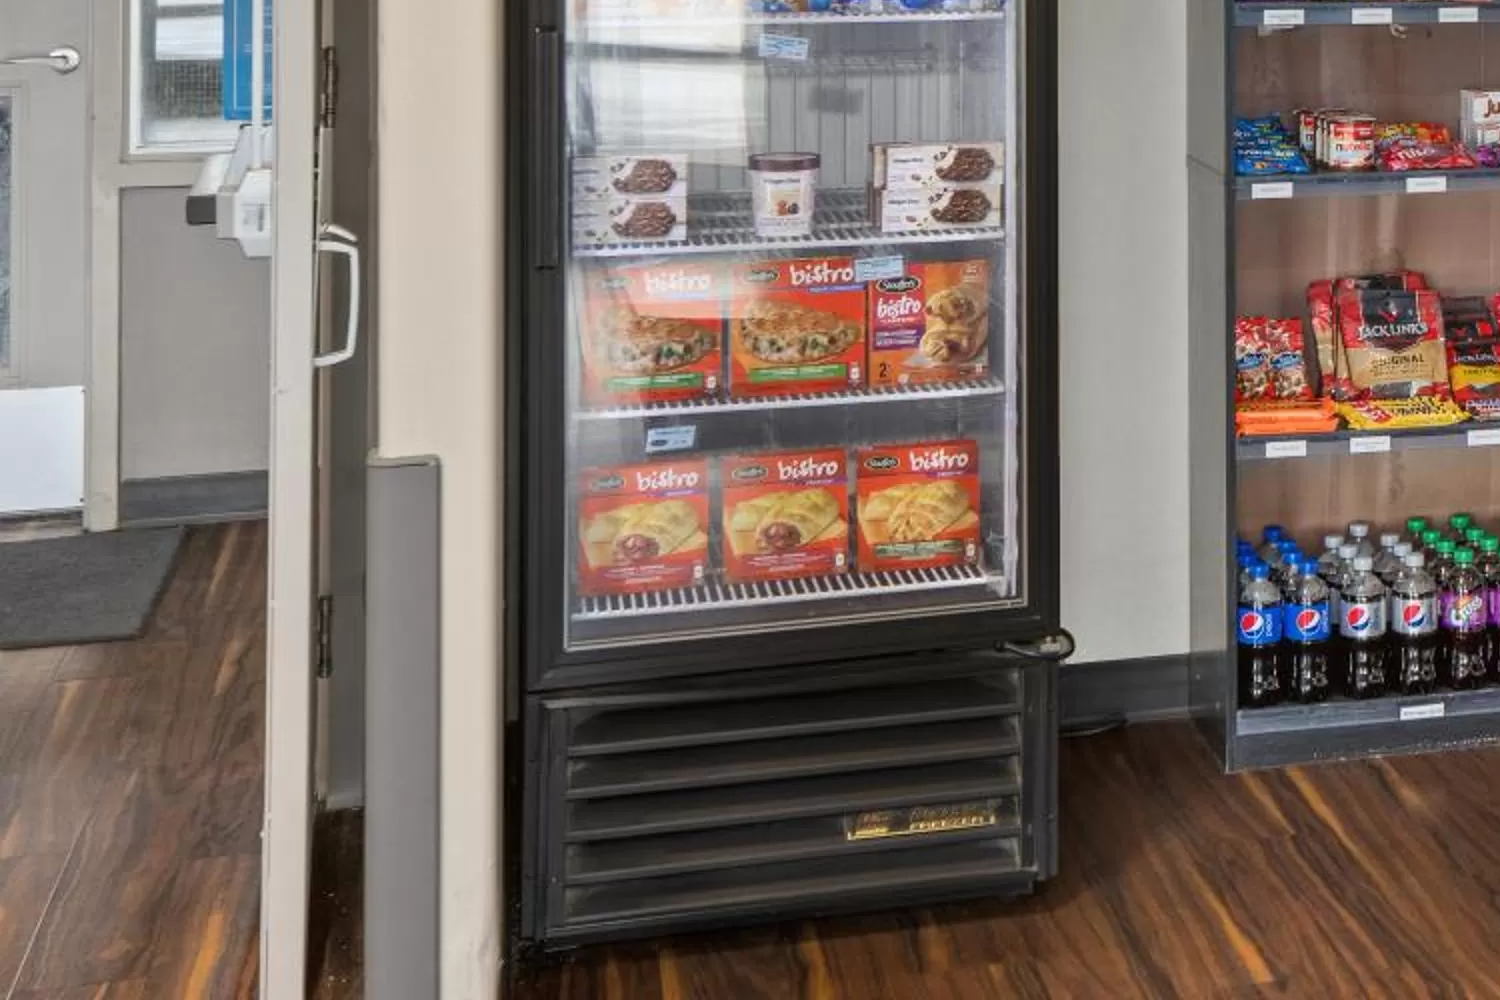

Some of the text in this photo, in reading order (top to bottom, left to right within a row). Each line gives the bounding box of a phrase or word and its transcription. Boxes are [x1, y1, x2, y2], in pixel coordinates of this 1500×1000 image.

[790, 262, 854, 285] bistro
[877, 295, 922, 319] bistro
[777, 456, 838, 480] bistro
[909, 449, 969, 474] bistro
[635, 467, 699, 491] bistro
